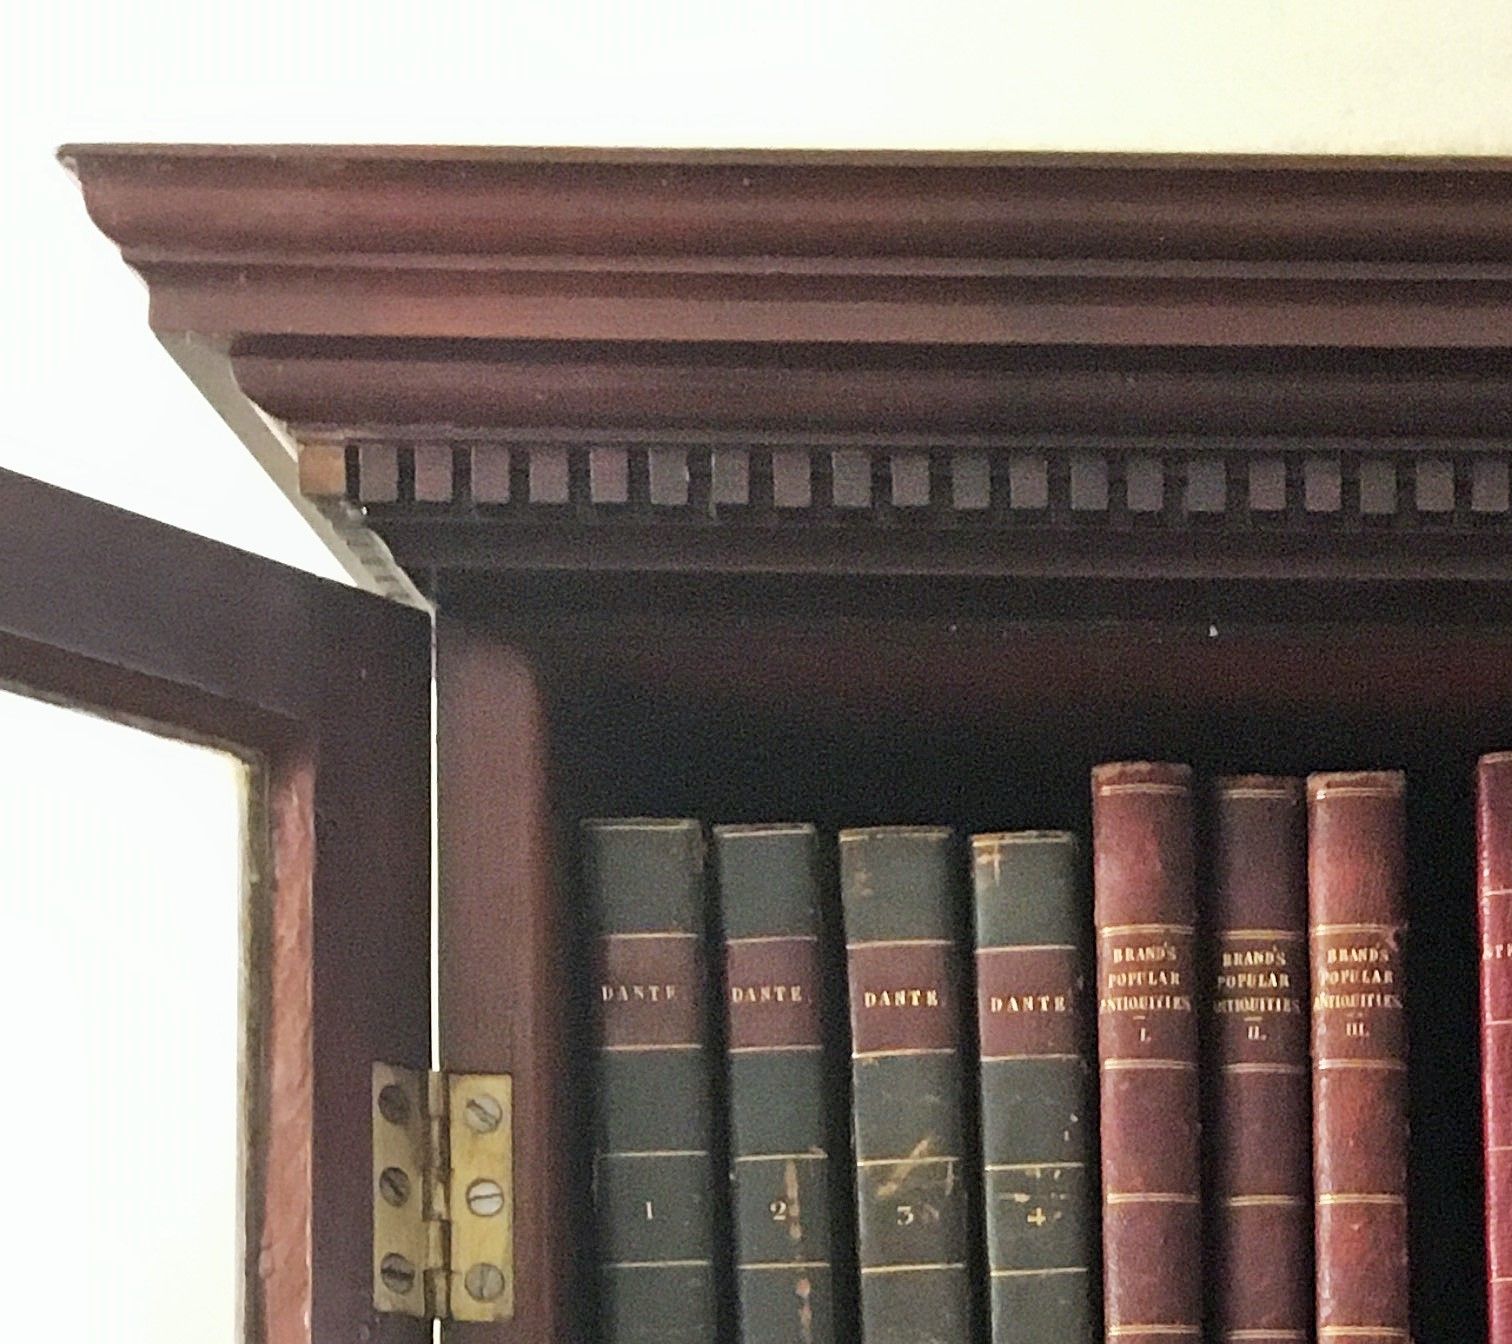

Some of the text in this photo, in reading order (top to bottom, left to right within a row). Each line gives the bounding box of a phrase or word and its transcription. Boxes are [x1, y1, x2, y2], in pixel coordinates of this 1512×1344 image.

[1112, 941, 1177, 963] BRAND'S
[1222, 946, 1287, 967] BRAND'S
[1327, 942, 1389, 963] BRAND'S
[1108, 970, 1180, 989] POPULAR
[1217, 972, 1290, 989] POPULAR
[1320, 969, 1393, 986] POPULAR
[601, 984, 676, 1001] DANTE
[731, 986, 802, 1003] DANTE
[864, 989, 938, 1008] DANTE
[990, 995, 1066, 1012] DANTE
[1099, 995, 1191, 1014] ANTIQUITIES
[645, 1201, 653, 1220] 1
[770, 1202, 787, 1221] 2
[897, 1206, 914, 1225] 3
